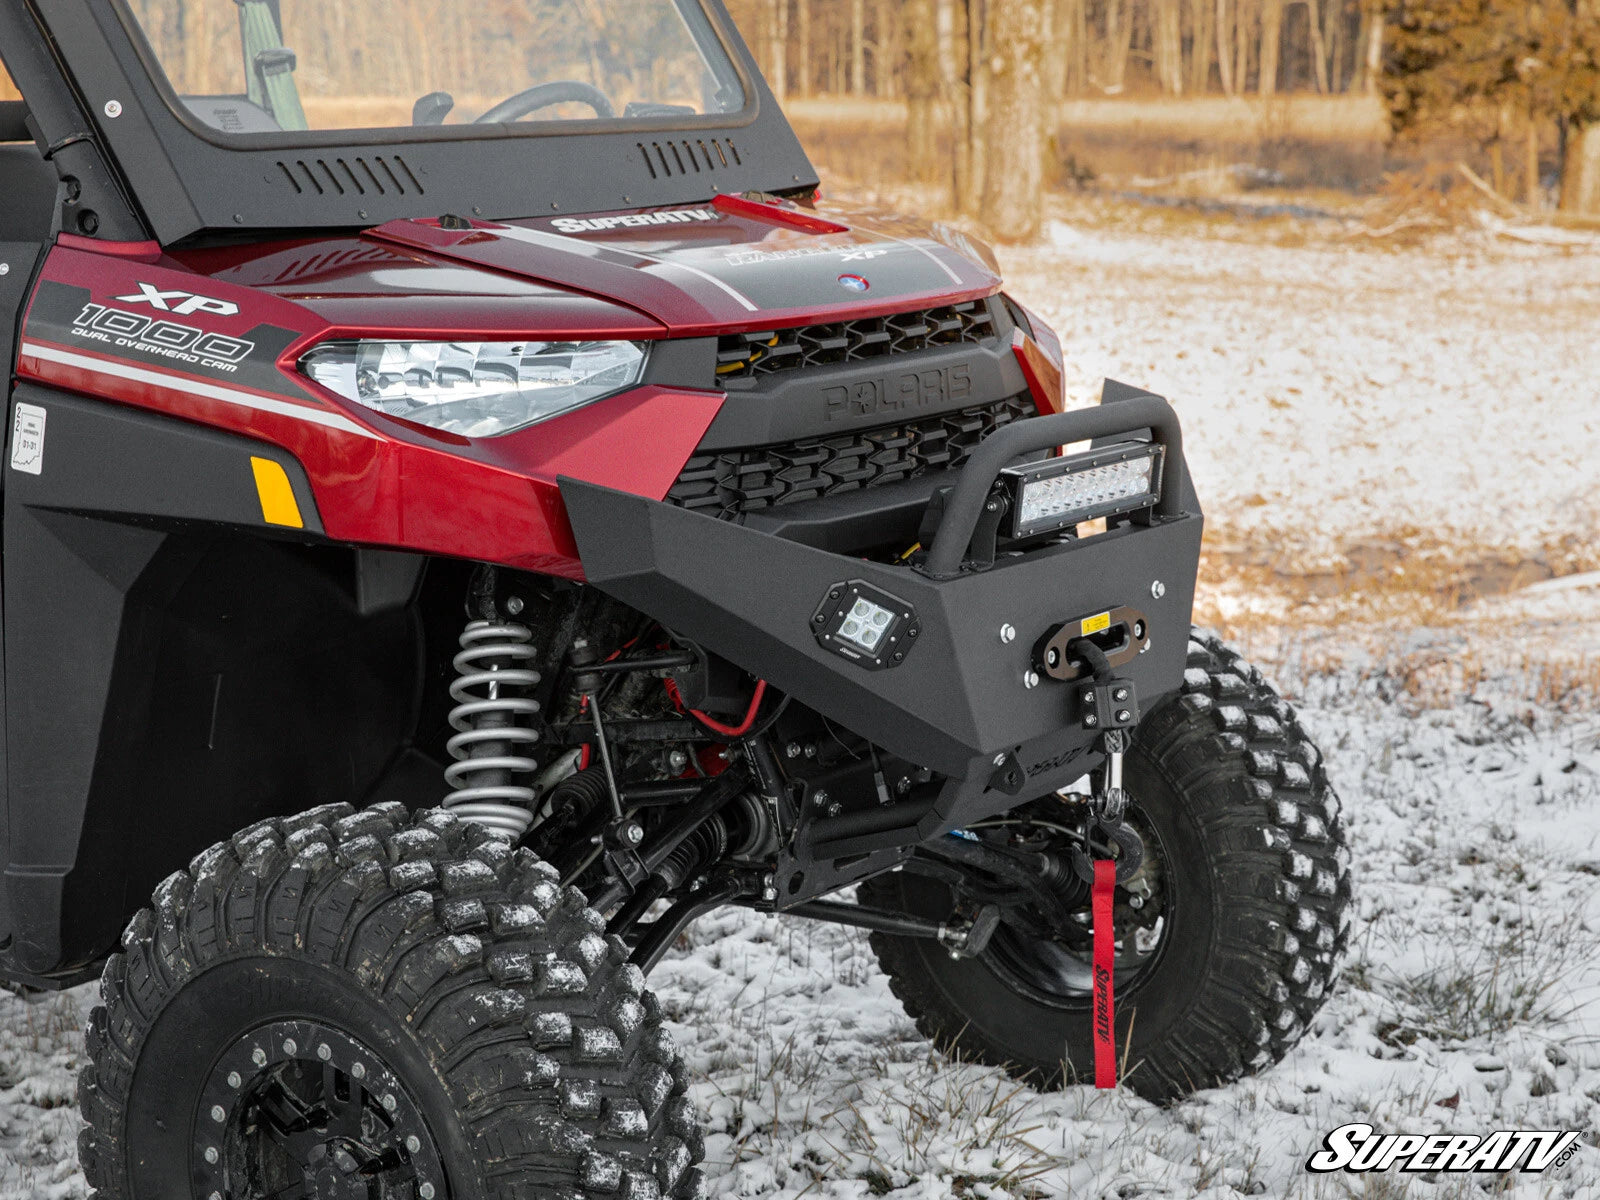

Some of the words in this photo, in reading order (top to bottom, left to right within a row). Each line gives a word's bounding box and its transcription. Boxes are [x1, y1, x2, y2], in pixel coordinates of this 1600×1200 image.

[550, 209, 712, 233] SUPERATV
[113, 281, 240, 316] XP
[71, 327, 111, 343] DUAL
[115, 337, 199, 363] OVERHEAD
[200, 358, 239, 373] CAM
[73, 302, 256, 363] 1000
[820, 363, 972, 422] POLARIS
